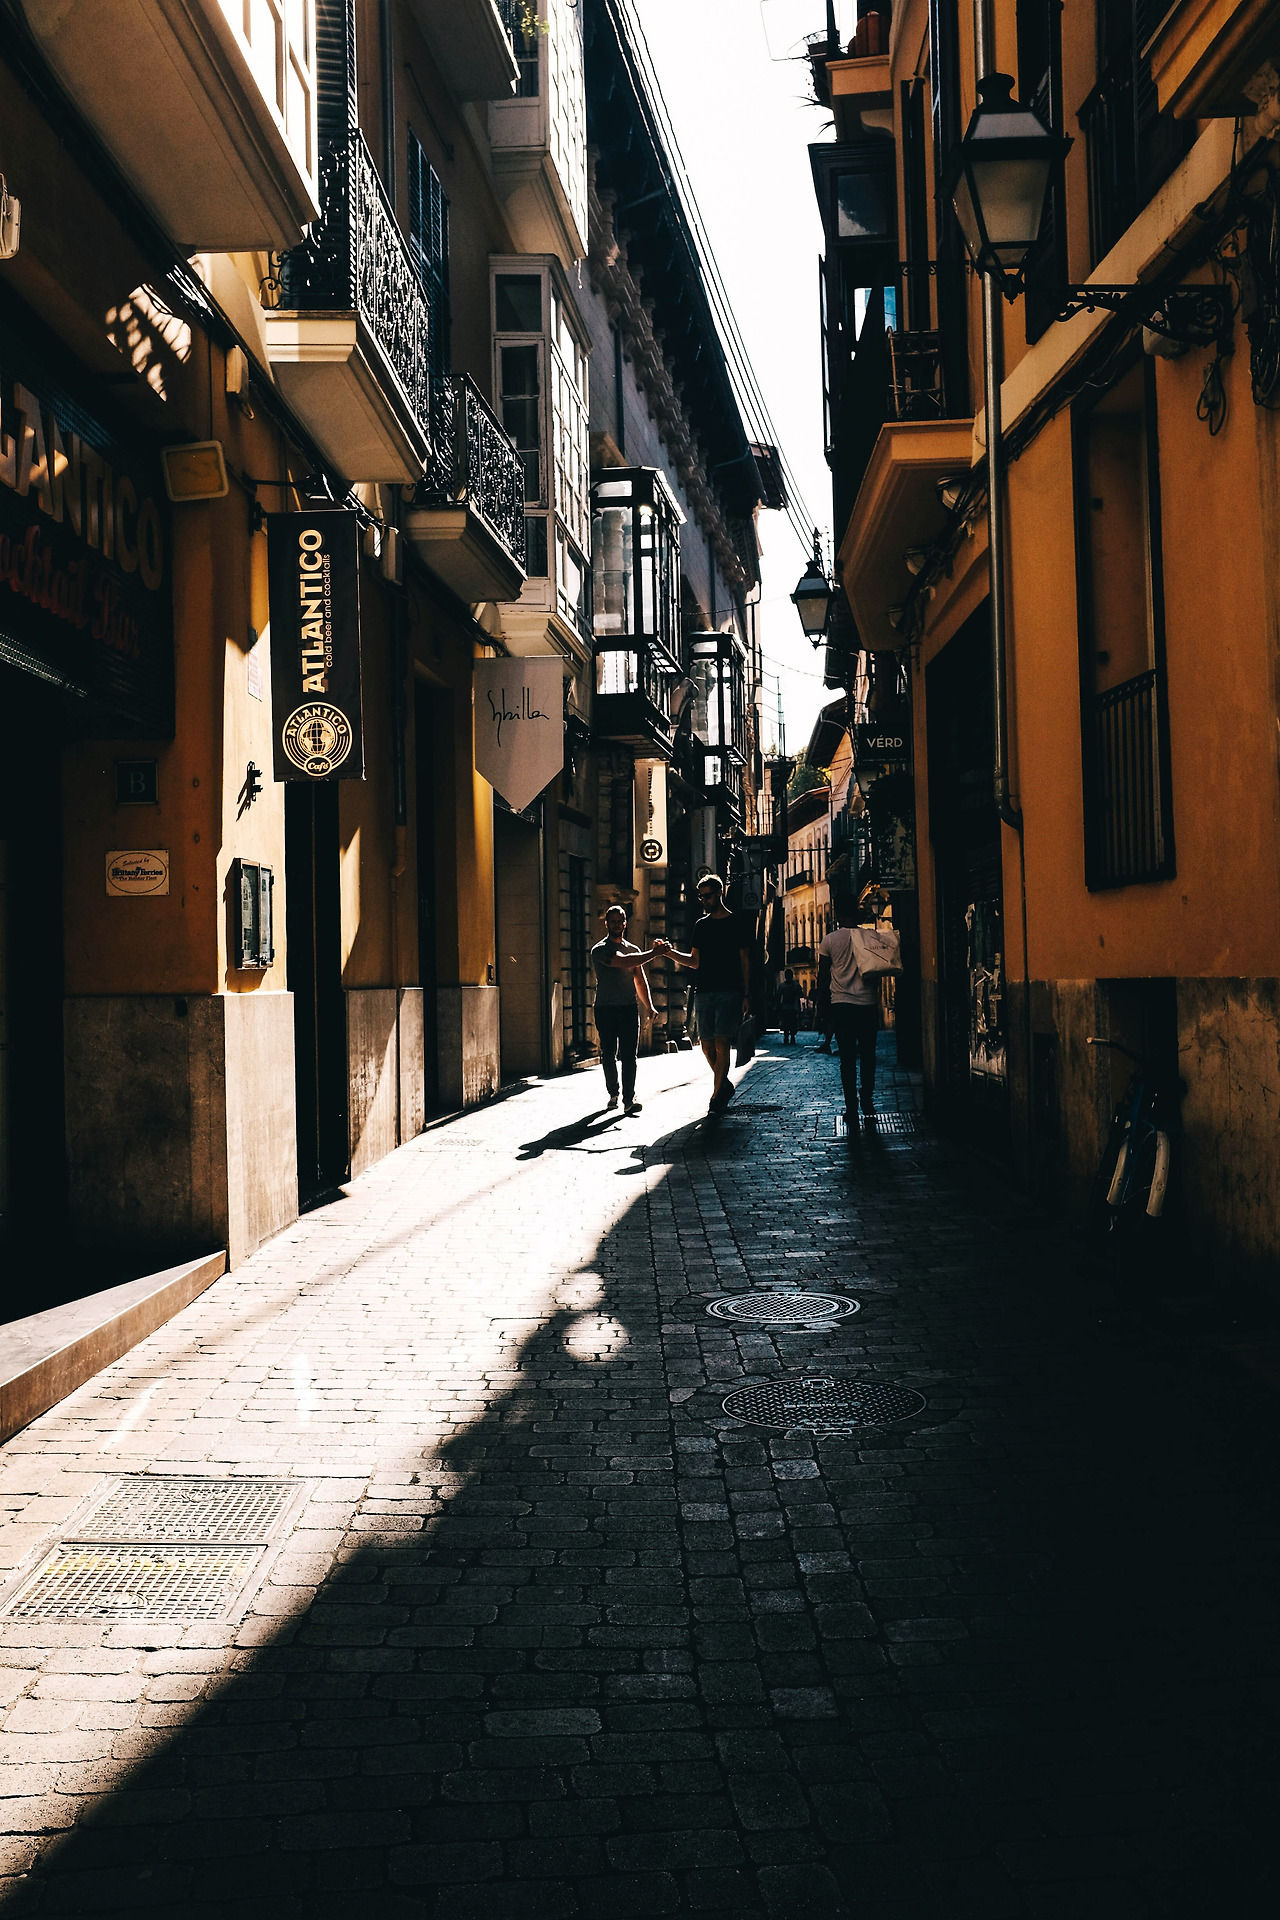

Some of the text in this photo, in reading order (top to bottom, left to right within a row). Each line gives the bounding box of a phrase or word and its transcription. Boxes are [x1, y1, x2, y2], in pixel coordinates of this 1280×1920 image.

[298, 529, 326, 694] ATLANTICO
[322, 554, 333, 668] cold beer and cocktails
[286, 706, 348, 738] ATLANTICO
[866, 734, 904, 748] VÉRD
[129, 771, 146, 793] B
[141, 868, 163, 876] Ferries
